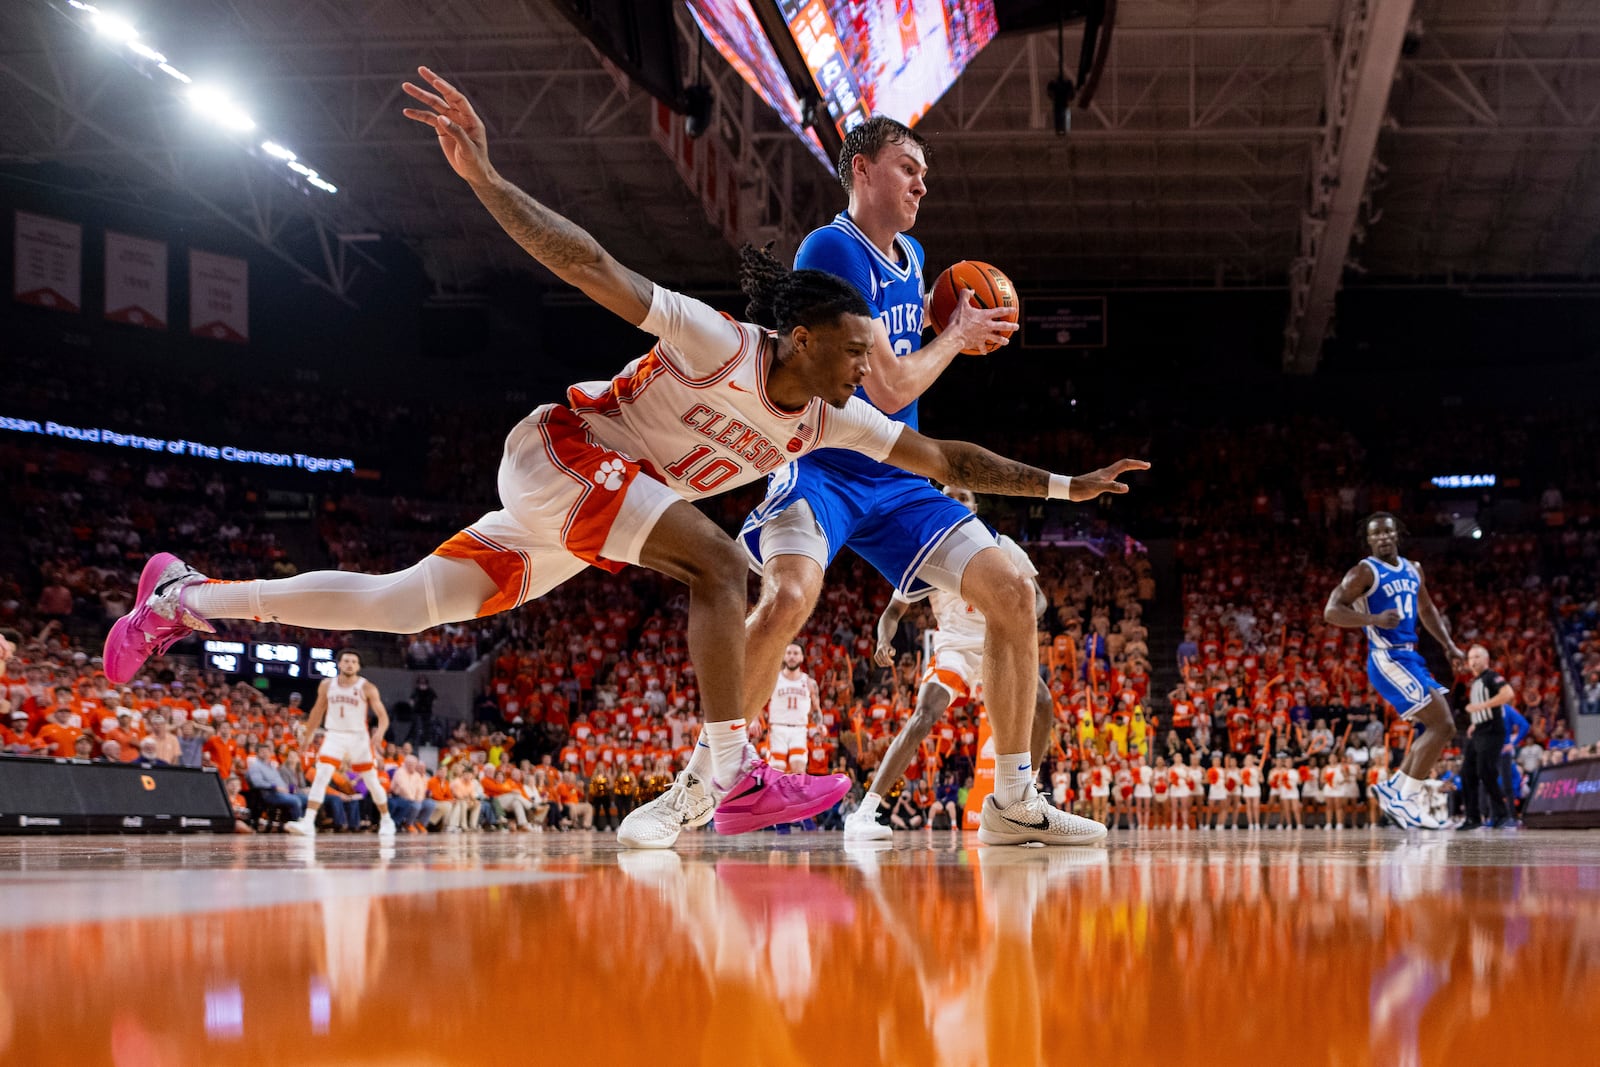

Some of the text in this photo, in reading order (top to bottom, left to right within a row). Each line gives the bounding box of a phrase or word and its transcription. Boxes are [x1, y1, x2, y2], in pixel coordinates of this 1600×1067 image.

[46, 421, 100, 442] Proud
[102, 429, 165, 451] Partner
[167, 440, 186, 455] of
[188, 441, 219, 460] The
[221, 446, 292, 467] Clemson
[664, 444, 743, 494] 10
[1382, 578, 1418, 598] DUKE
[1394, 593, 1413, 620] 14
[788, 696, 799, 710] 11
